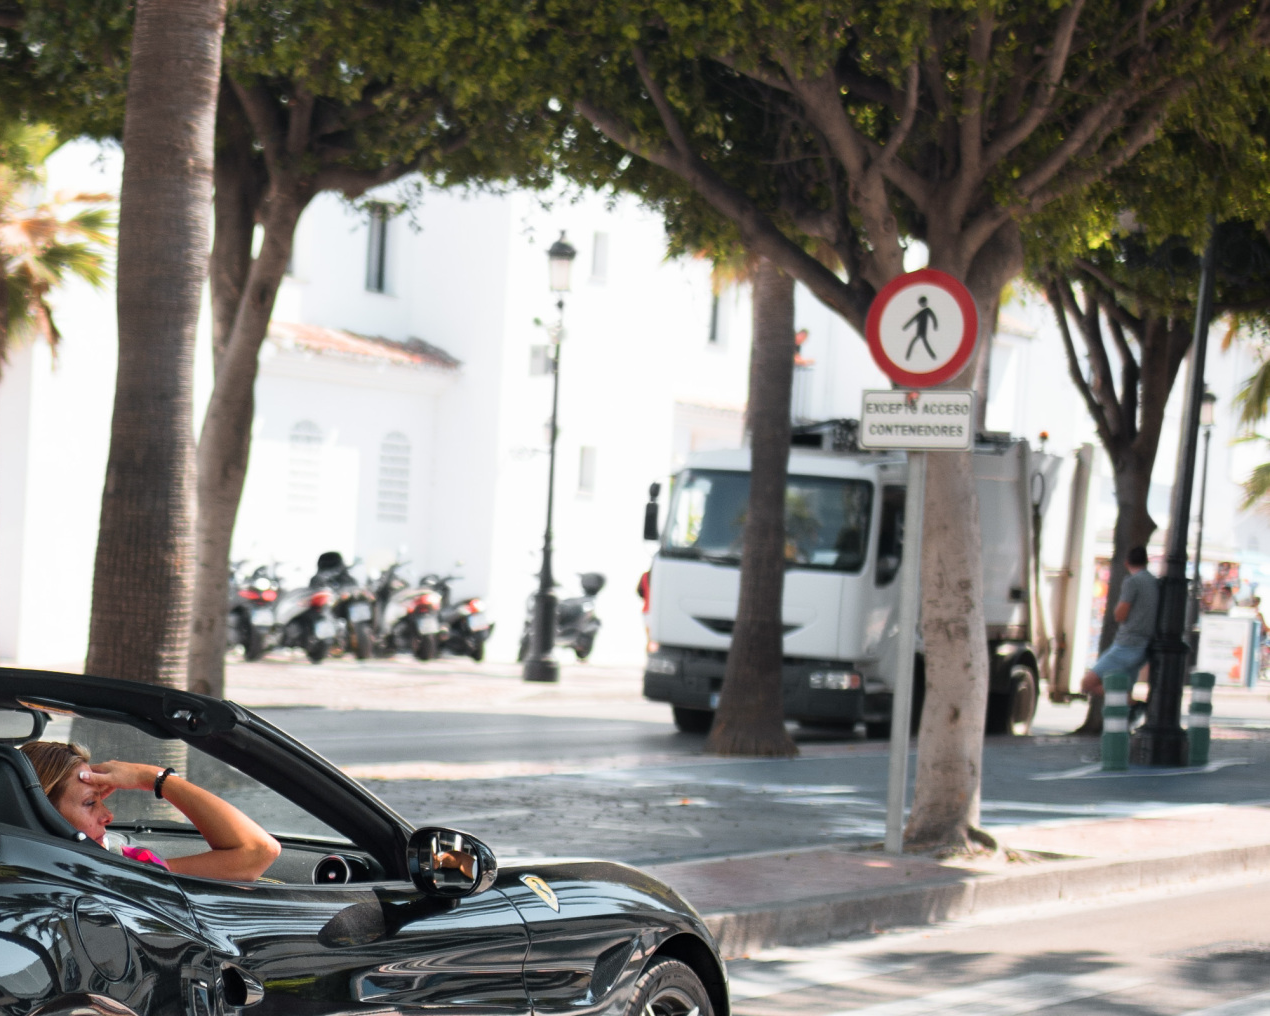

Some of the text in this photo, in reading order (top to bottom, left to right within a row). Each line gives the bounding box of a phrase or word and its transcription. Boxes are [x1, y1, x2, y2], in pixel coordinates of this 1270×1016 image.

[866, 403, 969, 416] EXCEPTO ACCESO
[869, 424, 963, 437] CONTENEDORES
